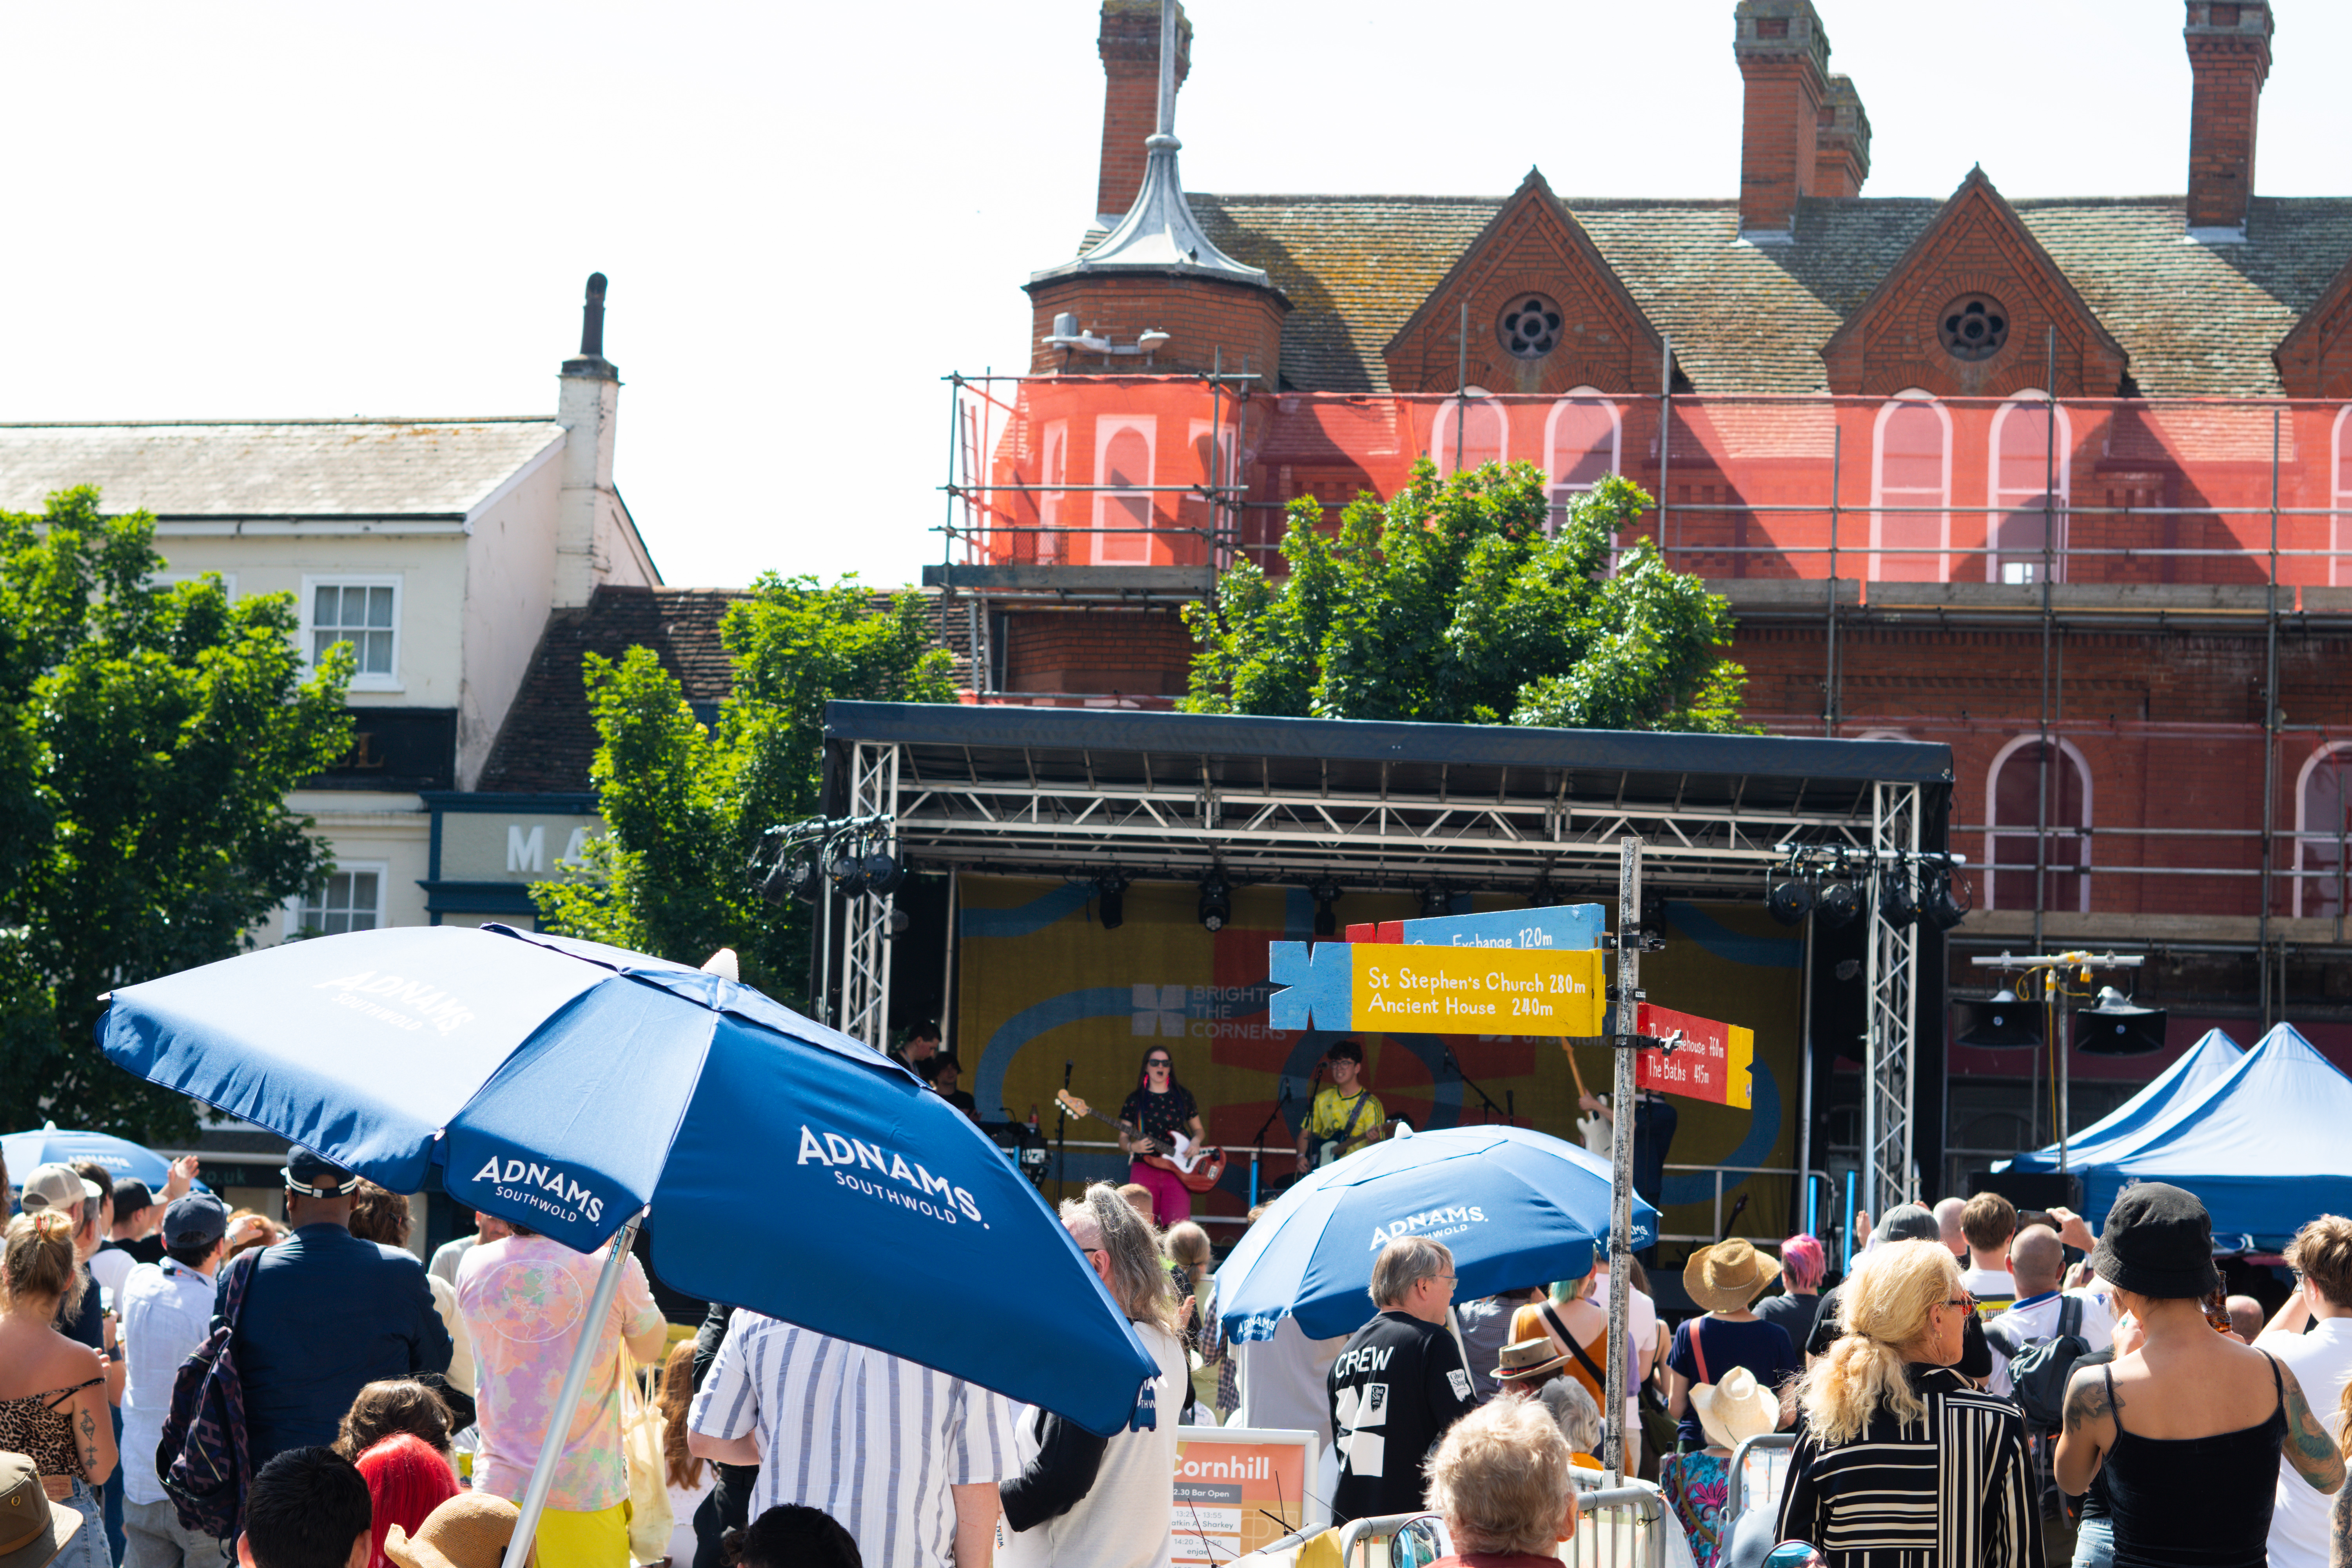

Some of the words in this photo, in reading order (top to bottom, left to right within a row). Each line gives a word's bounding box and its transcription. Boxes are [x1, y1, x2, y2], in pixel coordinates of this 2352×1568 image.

[1519, 927, 1552, 947] 120m
[1369, 967, 1390, 988] St
[1400, 967, 1480, 995] Stephen's
[1486, 972, 1544, 992] Church
[1550, 975, 1586, 993] 280m
[332, 993, 422, 1030] SOUTHWOLD
[1192, 1004, 1232, 1020] THE
[1368, 993, 1439, 1014] Ancient
[1446, 997, 1495, 1014] House
[1512, 998, 1553, 1016] 240m
[1191, 1022, 1287, 1040] CORNERS
[1709, 1036, 1724, 1058] 760m
[1648, 1055, 1661, 1078] The
[1664, 1058, 1686, 1081] Baths
[1694, 1064, 1709, 1083] 415m
[495, 1186, 577, 1221] SOUTHWOLD
[835, 1171, 956, 1224] SOUTHWOLD
[1335, 1347, 1394, 1378] CREW
[1173, 1454, 1269, 1479] Cornhill
[1203, 1521, 1233, 1530] Sharkey
